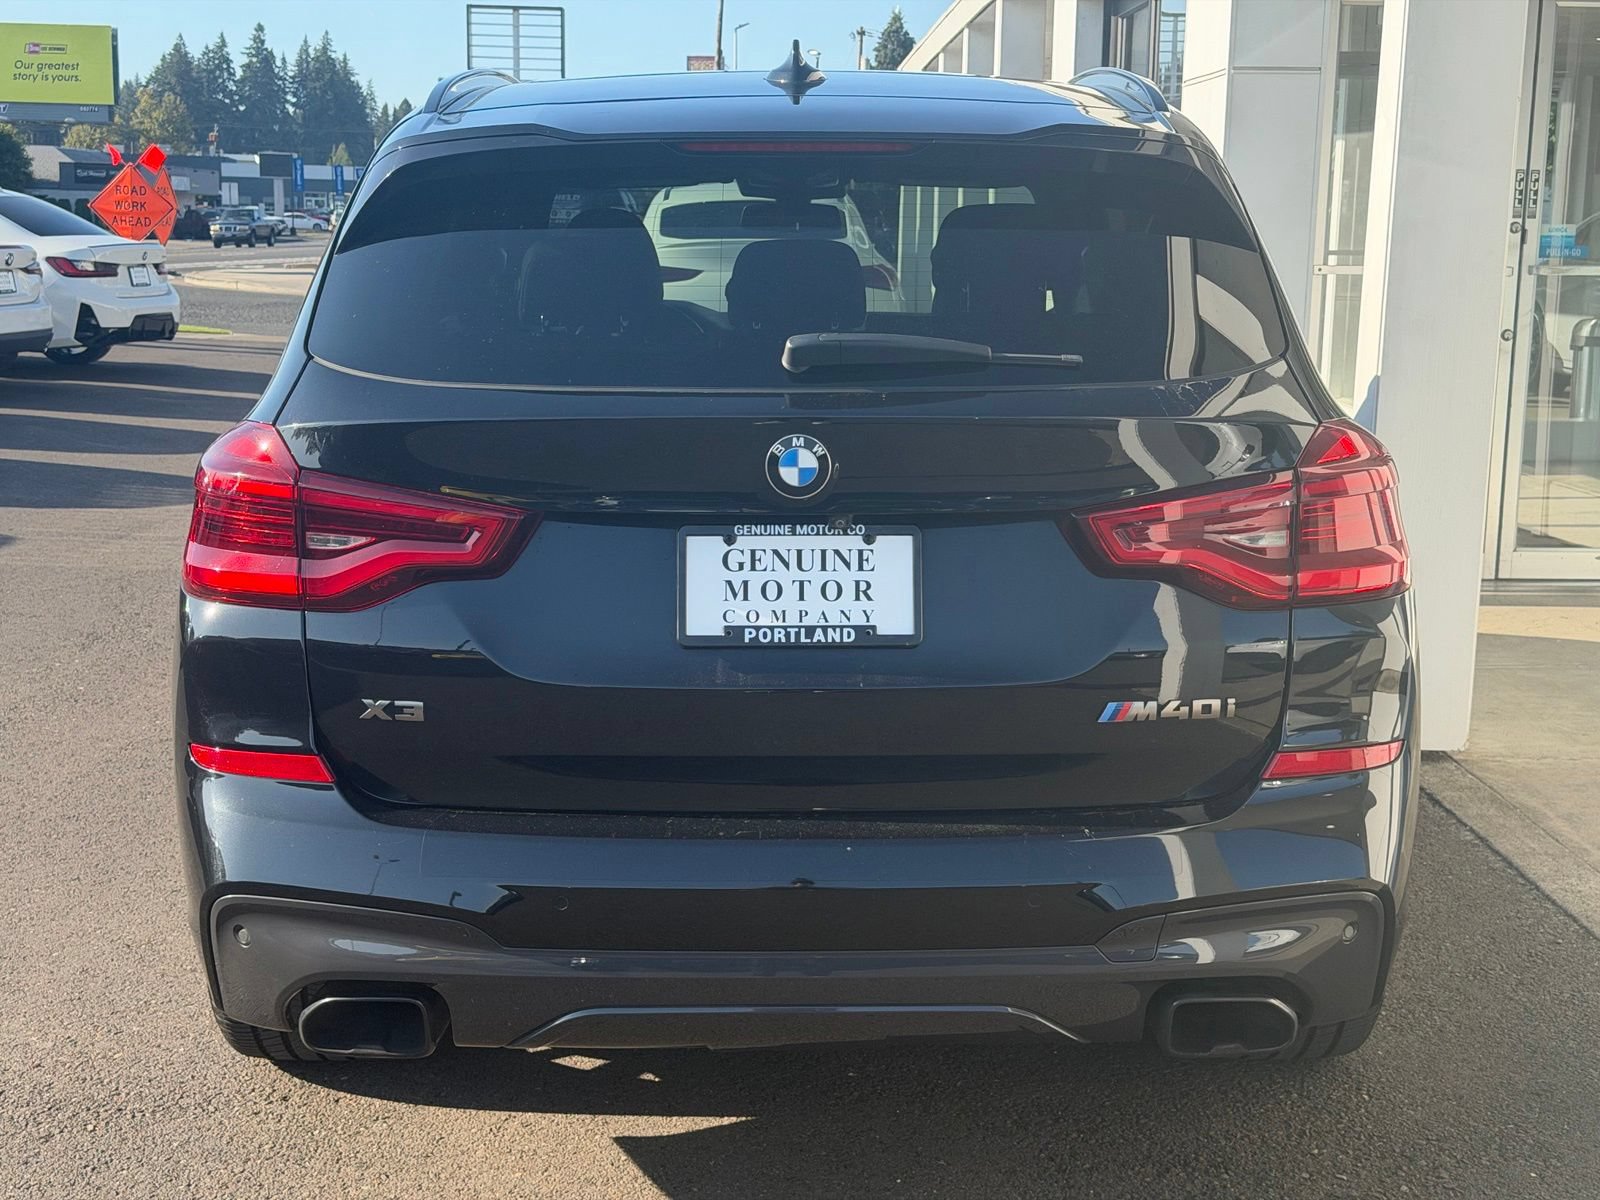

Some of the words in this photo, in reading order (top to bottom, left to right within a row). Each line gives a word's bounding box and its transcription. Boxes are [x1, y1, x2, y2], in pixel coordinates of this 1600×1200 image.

[14, 60, 34, 70] Our
[36, 62, 80, 72] greatest
[13, 72, 39, 83] story
[41, 71, 49, 81] is
[52, 74, 82, 84] yours.
[115, 185, 147, 196] ROAD
[1514, 172, 1524, 208] PULL
[1529, 173, 1539, 208] PULL
[114, 201, 147, 212] WORK
[111, 215, 152, 227] AHEAD
[772, 436, 826, 458] BMW
[734, 524, 793, 536] GENUINE
[847, 524, 866, 535] CO
[721, 548, 876, 573] GENUINE
[722, 579, 876, 602] MOTOR
[722, 609, 875, 624] COMPANY
[744, 627, 856, 643] PORTLAND
[359, 698, 425, 722] X3
[1097, 697, 1236, 723] M40i
